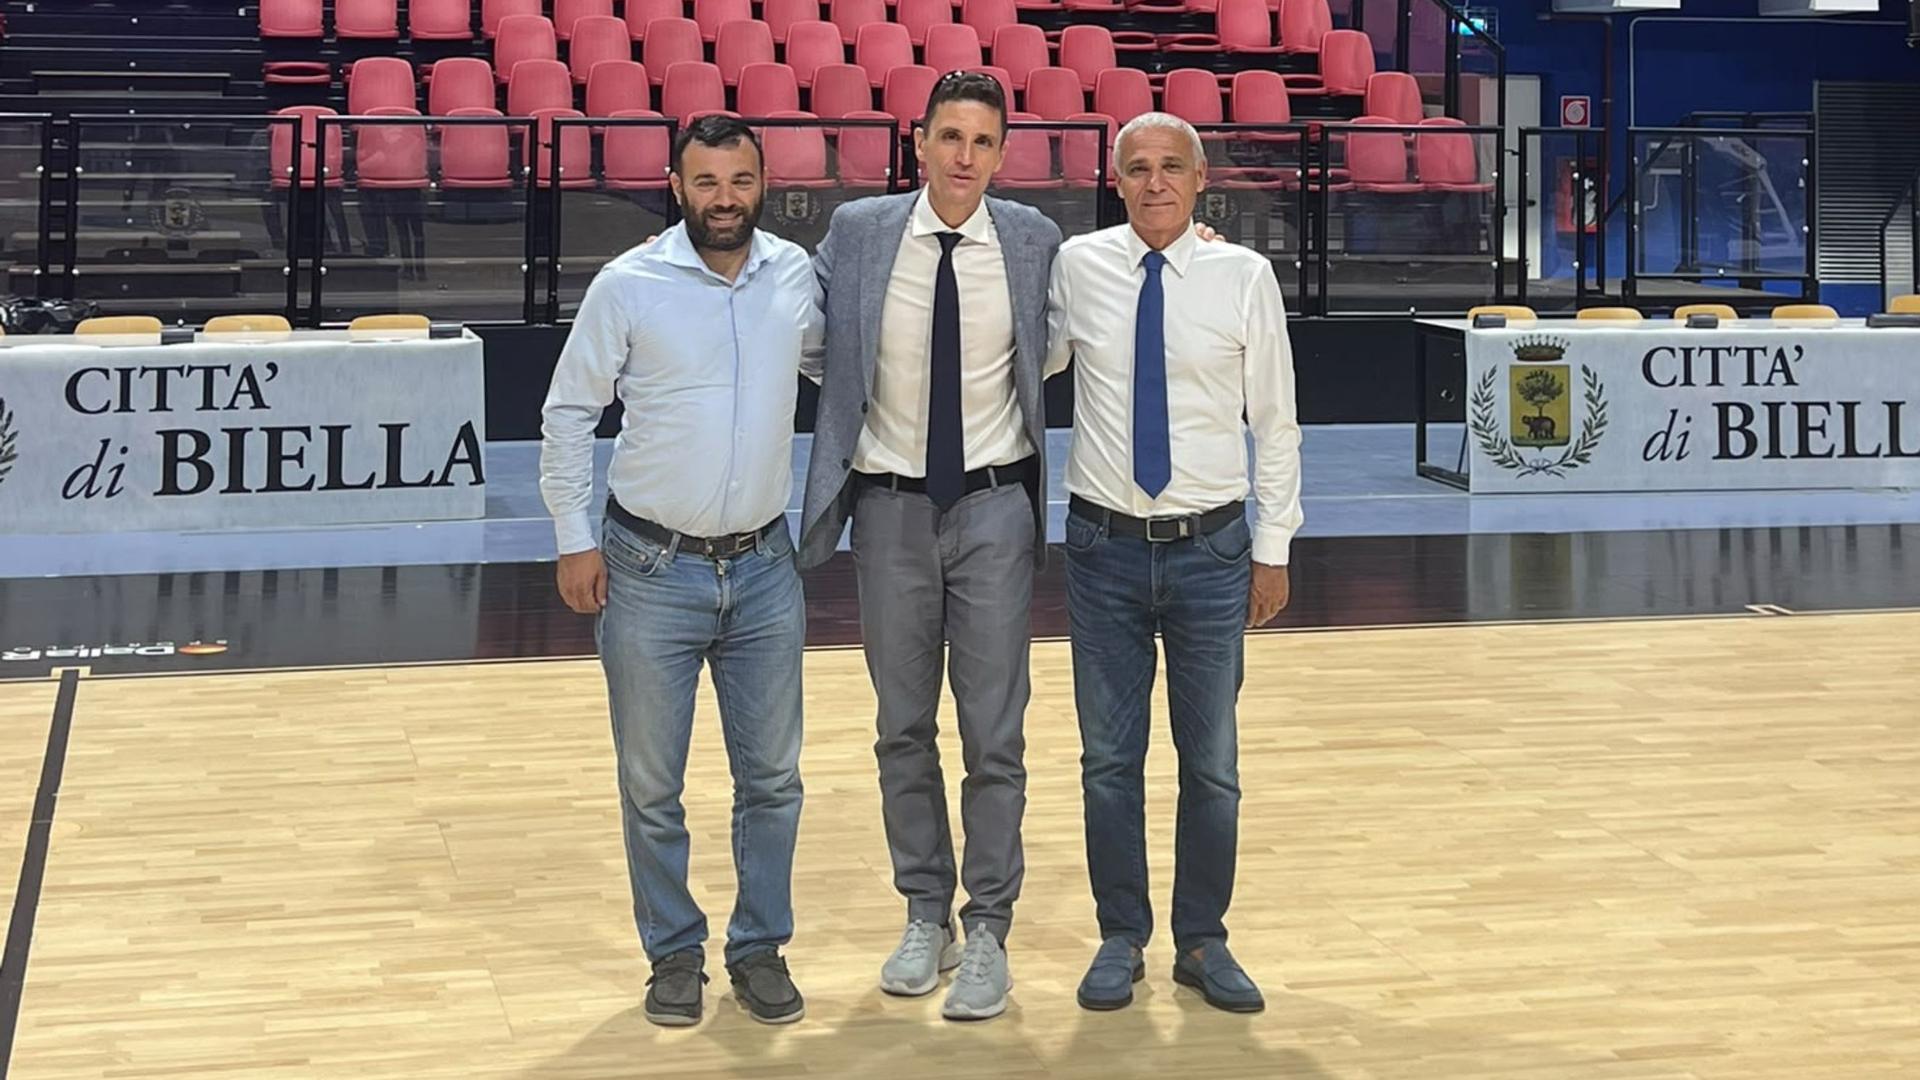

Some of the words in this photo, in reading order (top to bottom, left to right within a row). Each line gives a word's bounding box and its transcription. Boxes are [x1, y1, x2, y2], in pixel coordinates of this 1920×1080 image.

[65, 362, 278, 414] CITTA’
[1642, 345, 1803, 387] CITTA’
[1643, 408, 1691, 461] di
[1712, 401, 1920, 459] BIELL
[62, 438, 128, 499] di
[153, 420, 485, 496] BIELLA
